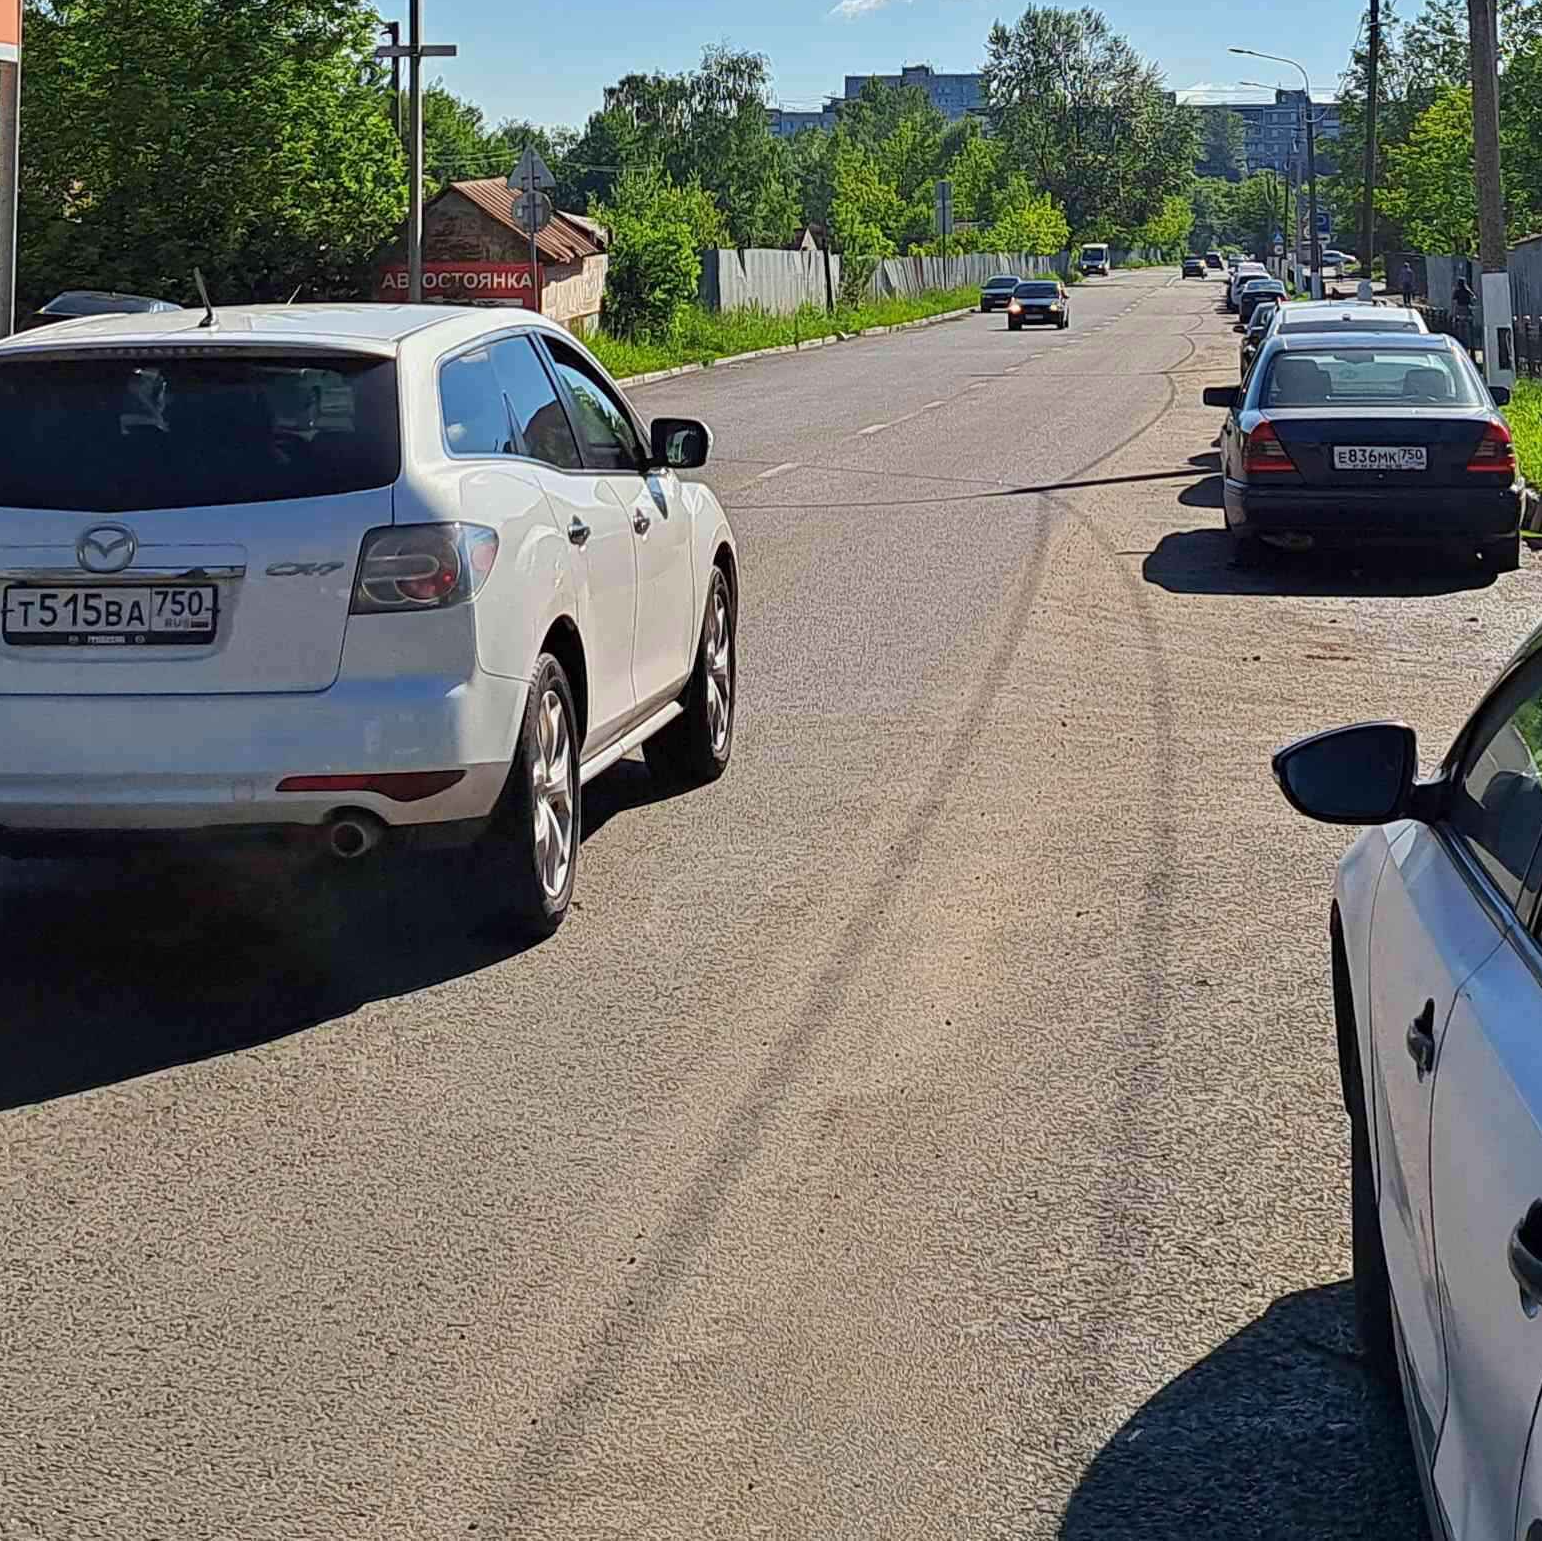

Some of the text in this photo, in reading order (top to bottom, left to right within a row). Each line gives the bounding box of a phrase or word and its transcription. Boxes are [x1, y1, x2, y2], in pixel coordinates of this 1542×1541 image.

[381, 271, 533, 289] АВОСТОЯНКА
[1401, 448, 1424, 460] 750
[18, 590, 205, 627] Т515ВА 750
